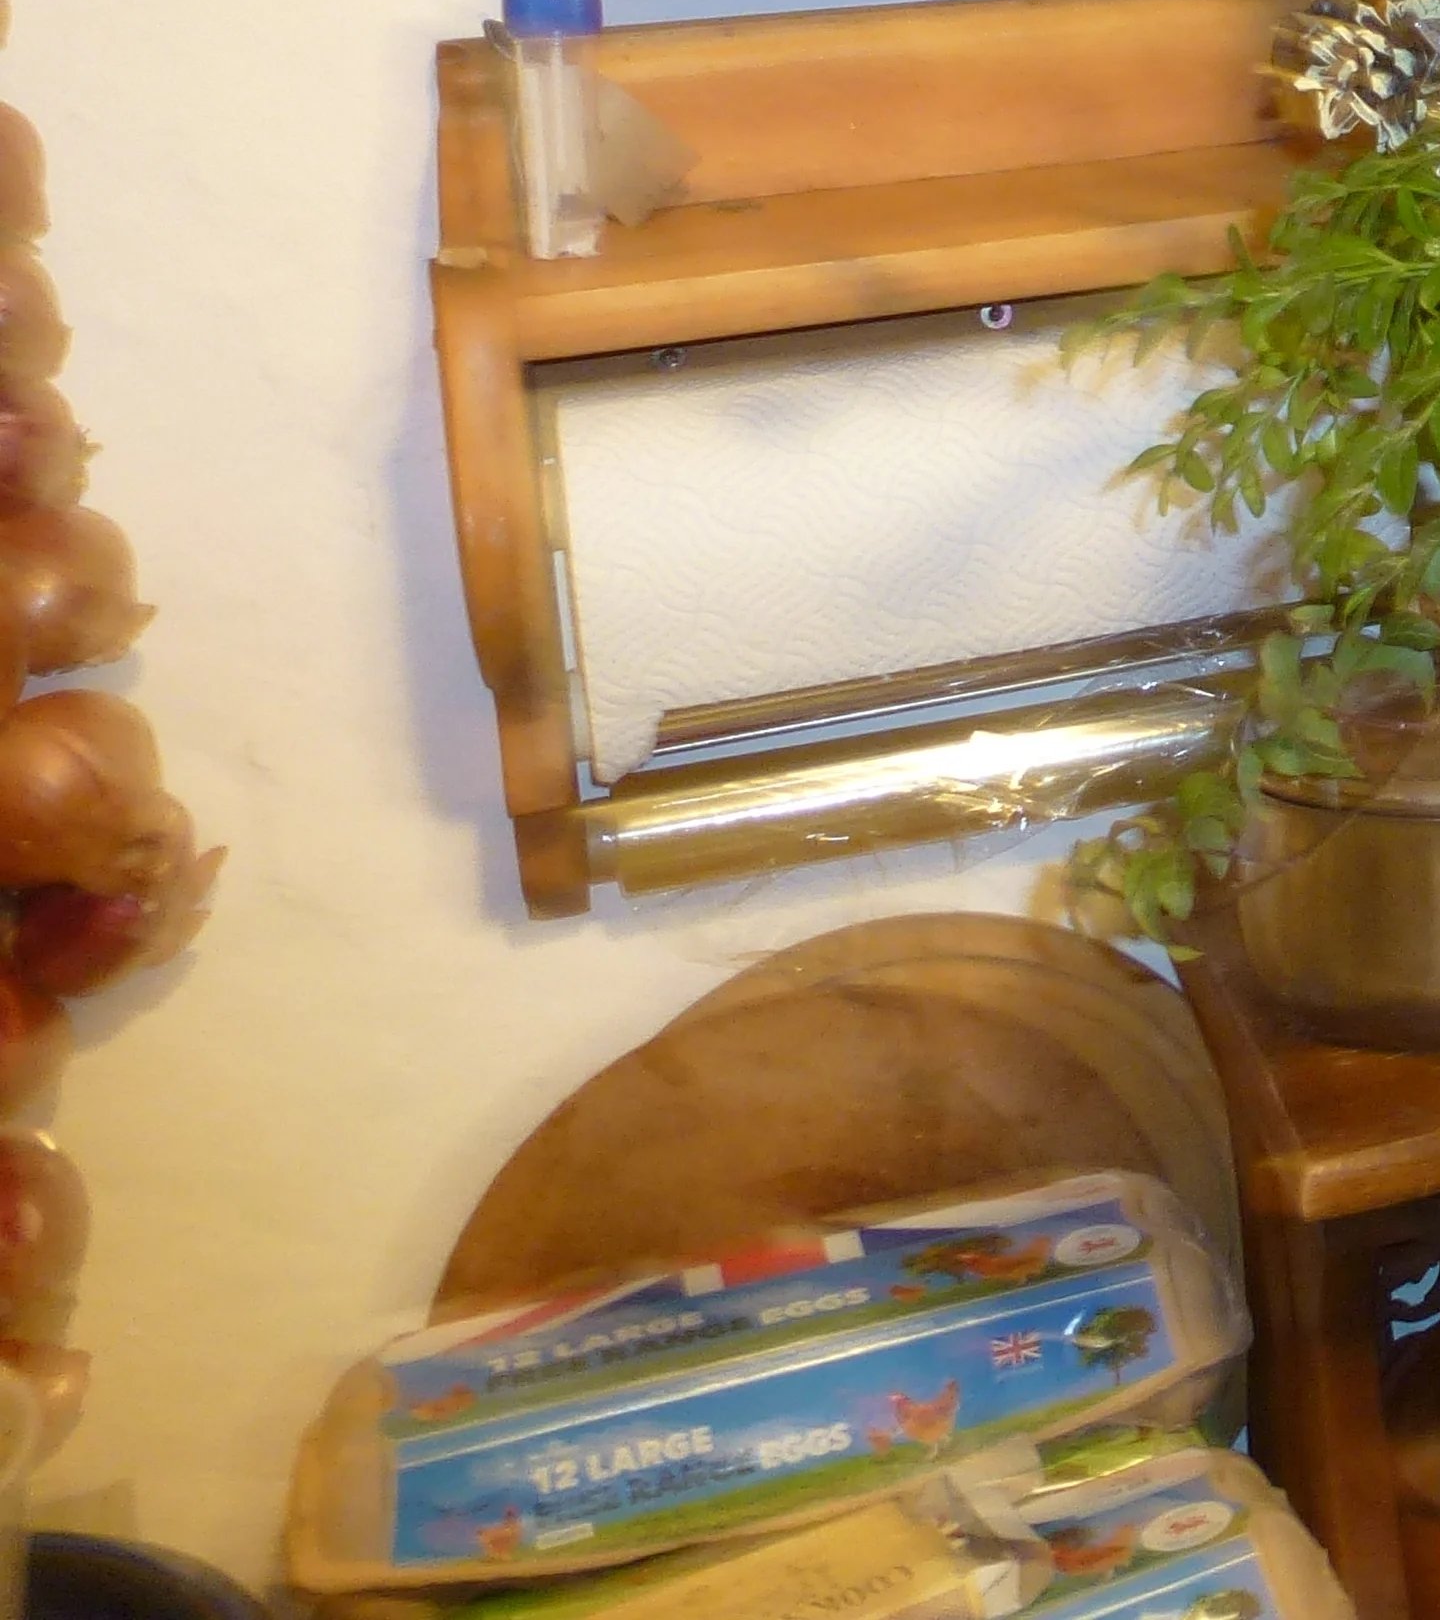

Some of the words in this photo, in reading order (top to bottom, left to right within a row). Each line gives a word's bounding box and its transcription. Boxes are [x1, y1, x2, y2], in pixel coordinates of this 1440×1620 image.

[758, 1287, 873, 1325] EGGS
[529, 1459, 582, 1494] 12
[584, 1424, 716, 1482] LARGE
[756, 1421, 853, 1471] EGGS
